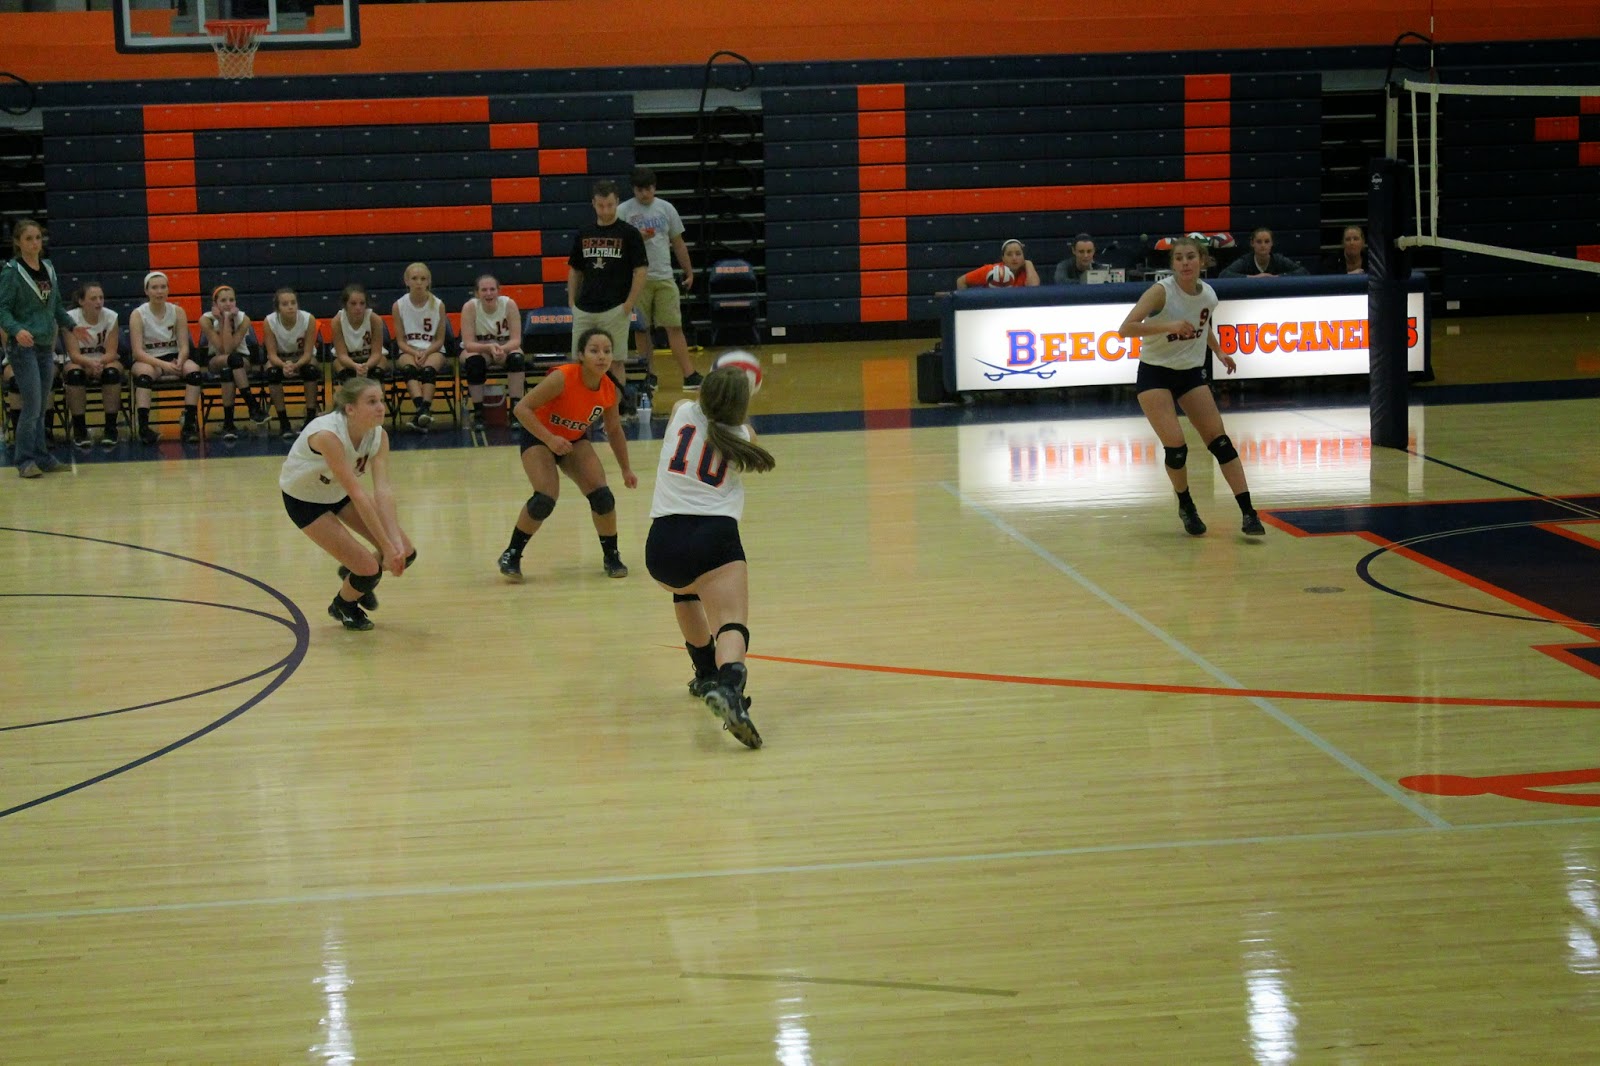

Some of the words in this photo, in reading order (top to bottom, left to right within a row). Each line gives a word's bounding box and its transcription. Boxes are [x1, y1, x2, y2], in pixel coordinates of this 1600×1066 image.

[582, 238, 623, 248] BEECH
[423, 318, 433, 333] 5
[530, 314, 573, 324] BEECH
[1200, 307, 1210, 327] 9
[495, 318, 510, 336] 14
[1217, 316, 1419, 356] BUCCANES
[549, 413, 588, 432] BEEC
[667, 423, 729, 489] 10
